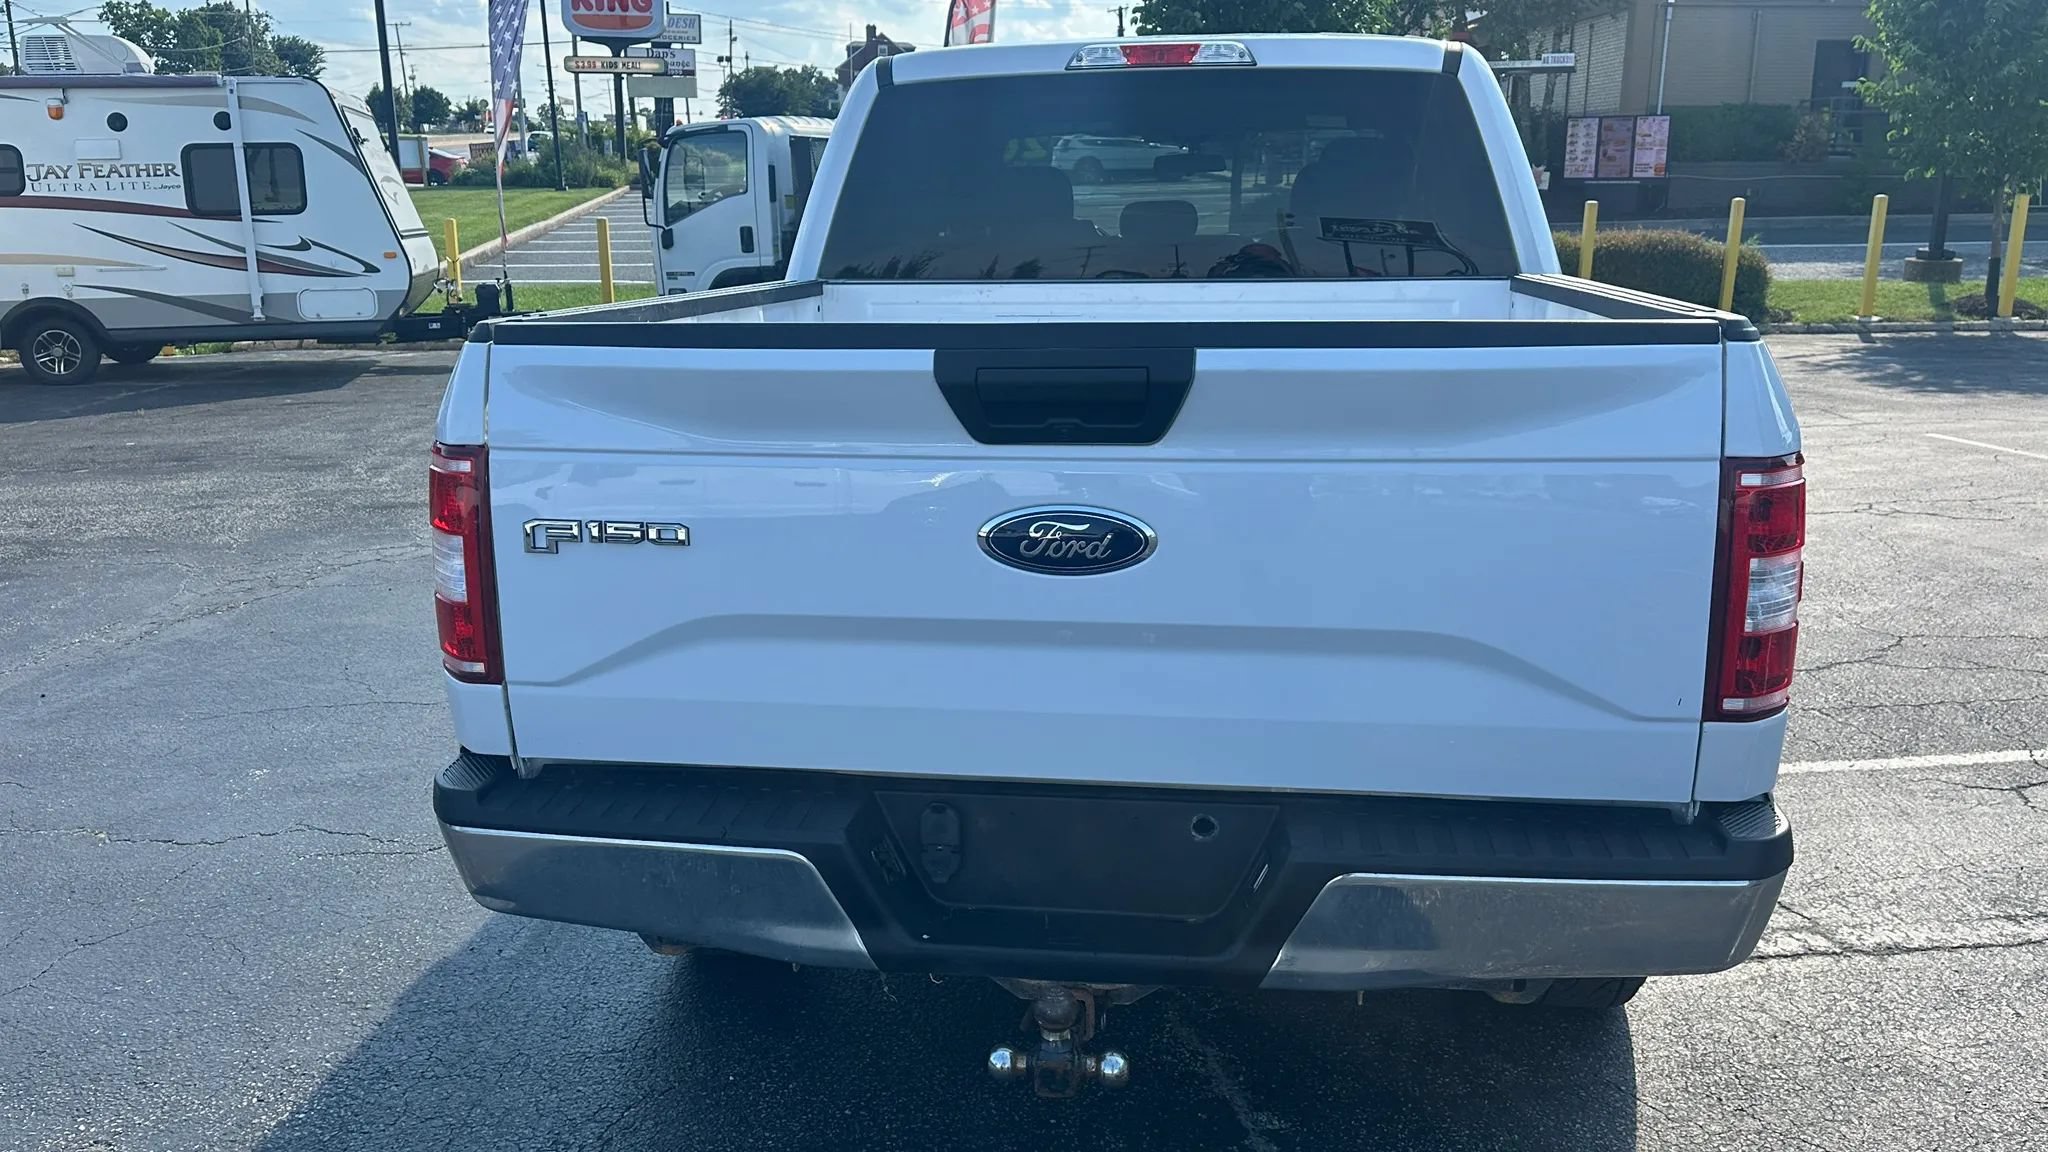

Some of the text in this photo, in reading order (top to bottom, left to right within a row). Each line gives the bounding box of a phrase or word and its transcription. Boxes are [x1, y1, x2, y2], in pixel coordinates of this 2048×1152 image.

[600, 61, 619, 69] KIDS
[26, 162, 180, 182] JAY FEATHER
[31, 182, 98, 193] ULTRA
[106, 180, 151, 192] LITE
[1019, 520, 1112, 559] Ford
